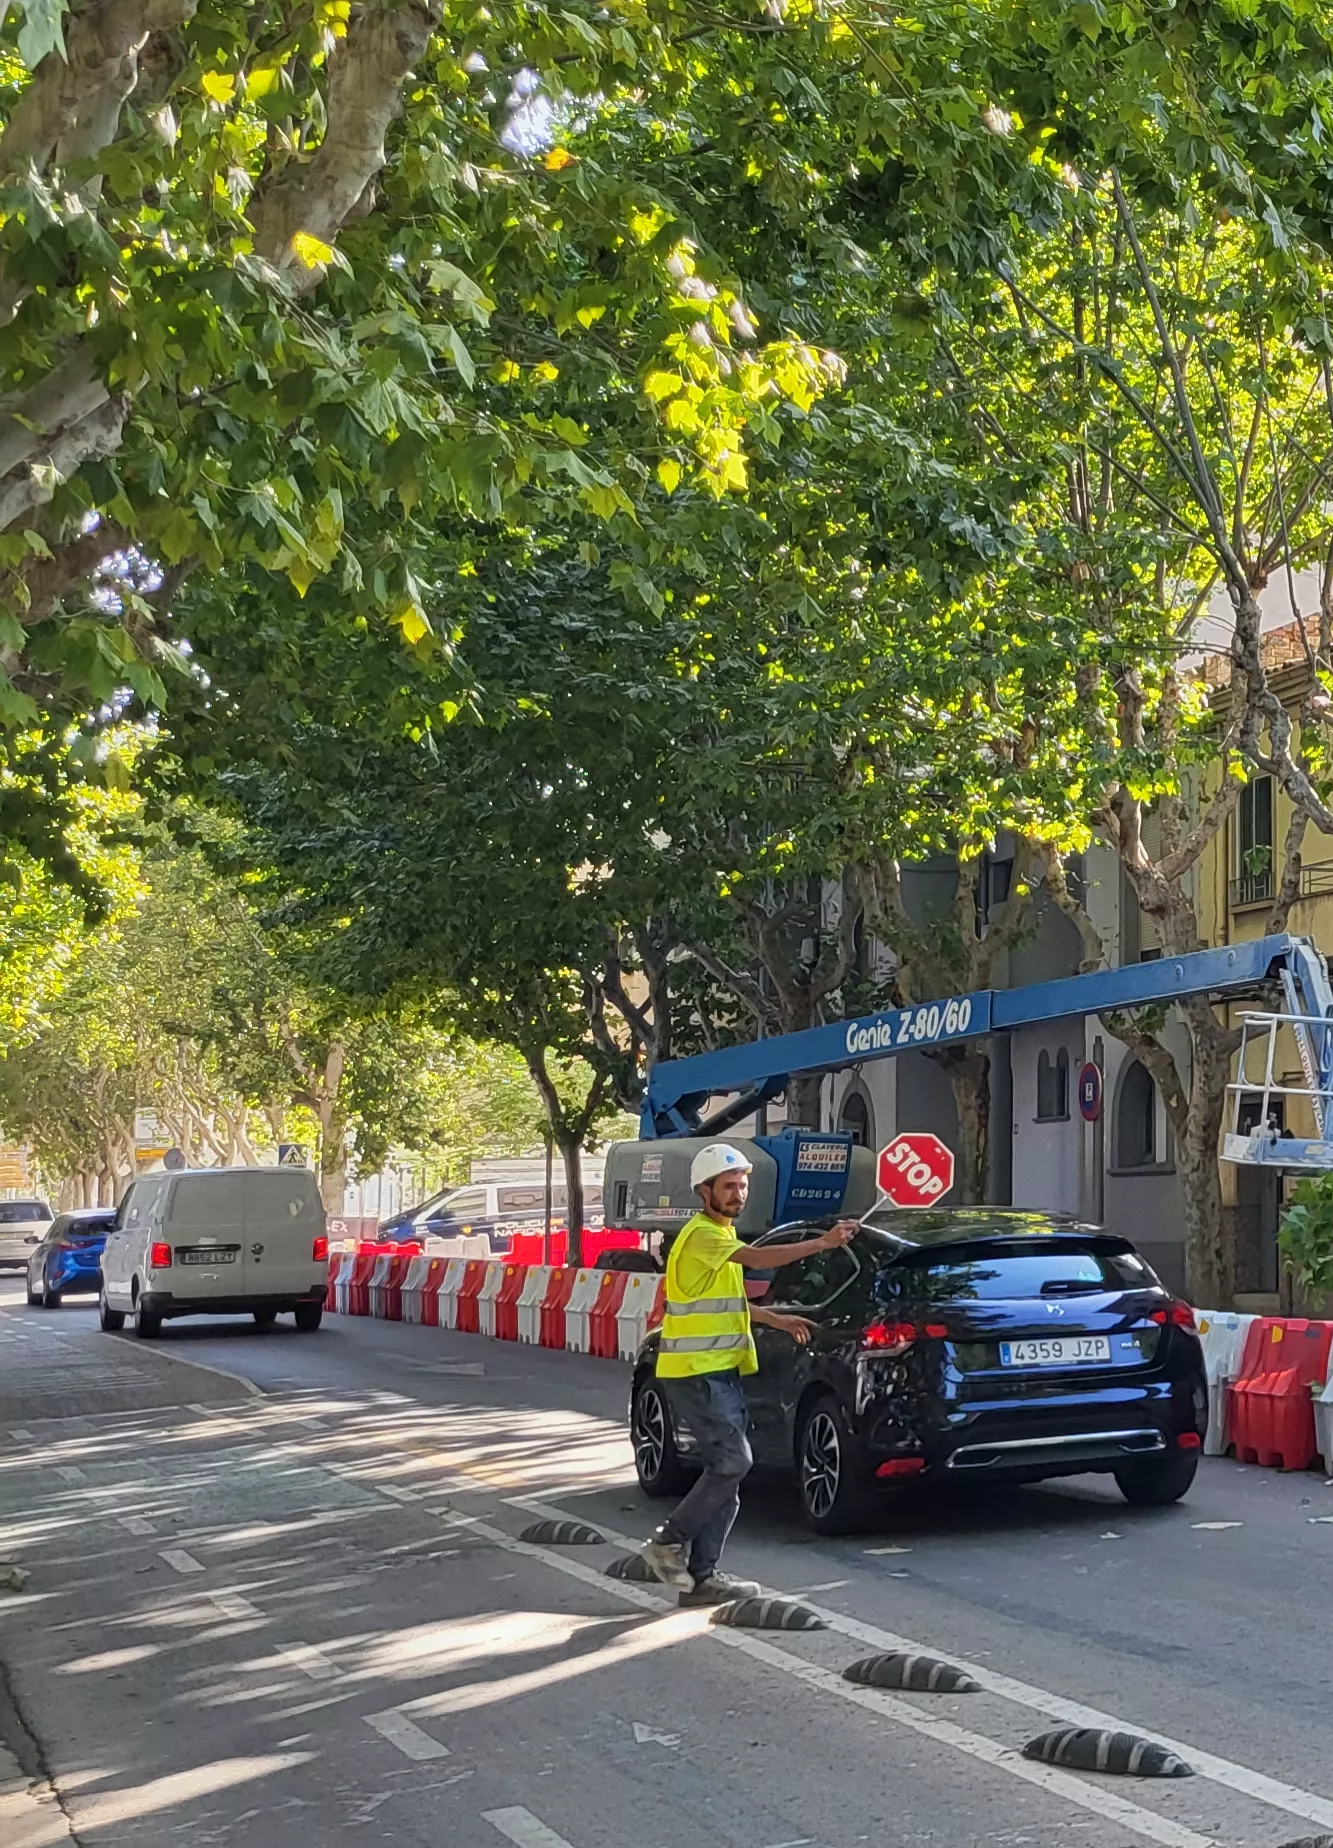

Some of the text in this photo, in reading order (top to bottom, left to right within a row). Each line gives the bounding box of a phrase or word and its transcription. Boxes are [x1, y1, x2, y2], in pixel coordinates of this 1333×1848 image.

[846, 998, 972, 1053] Genie Z-80/60
[800, 1153, 847, 1162] ALQUILER
[886, 1142, 944, 1196] STOP
[1014, 1341, 1064, 1361] 4359
[1072, 1339, 1106, 1358] JZP
